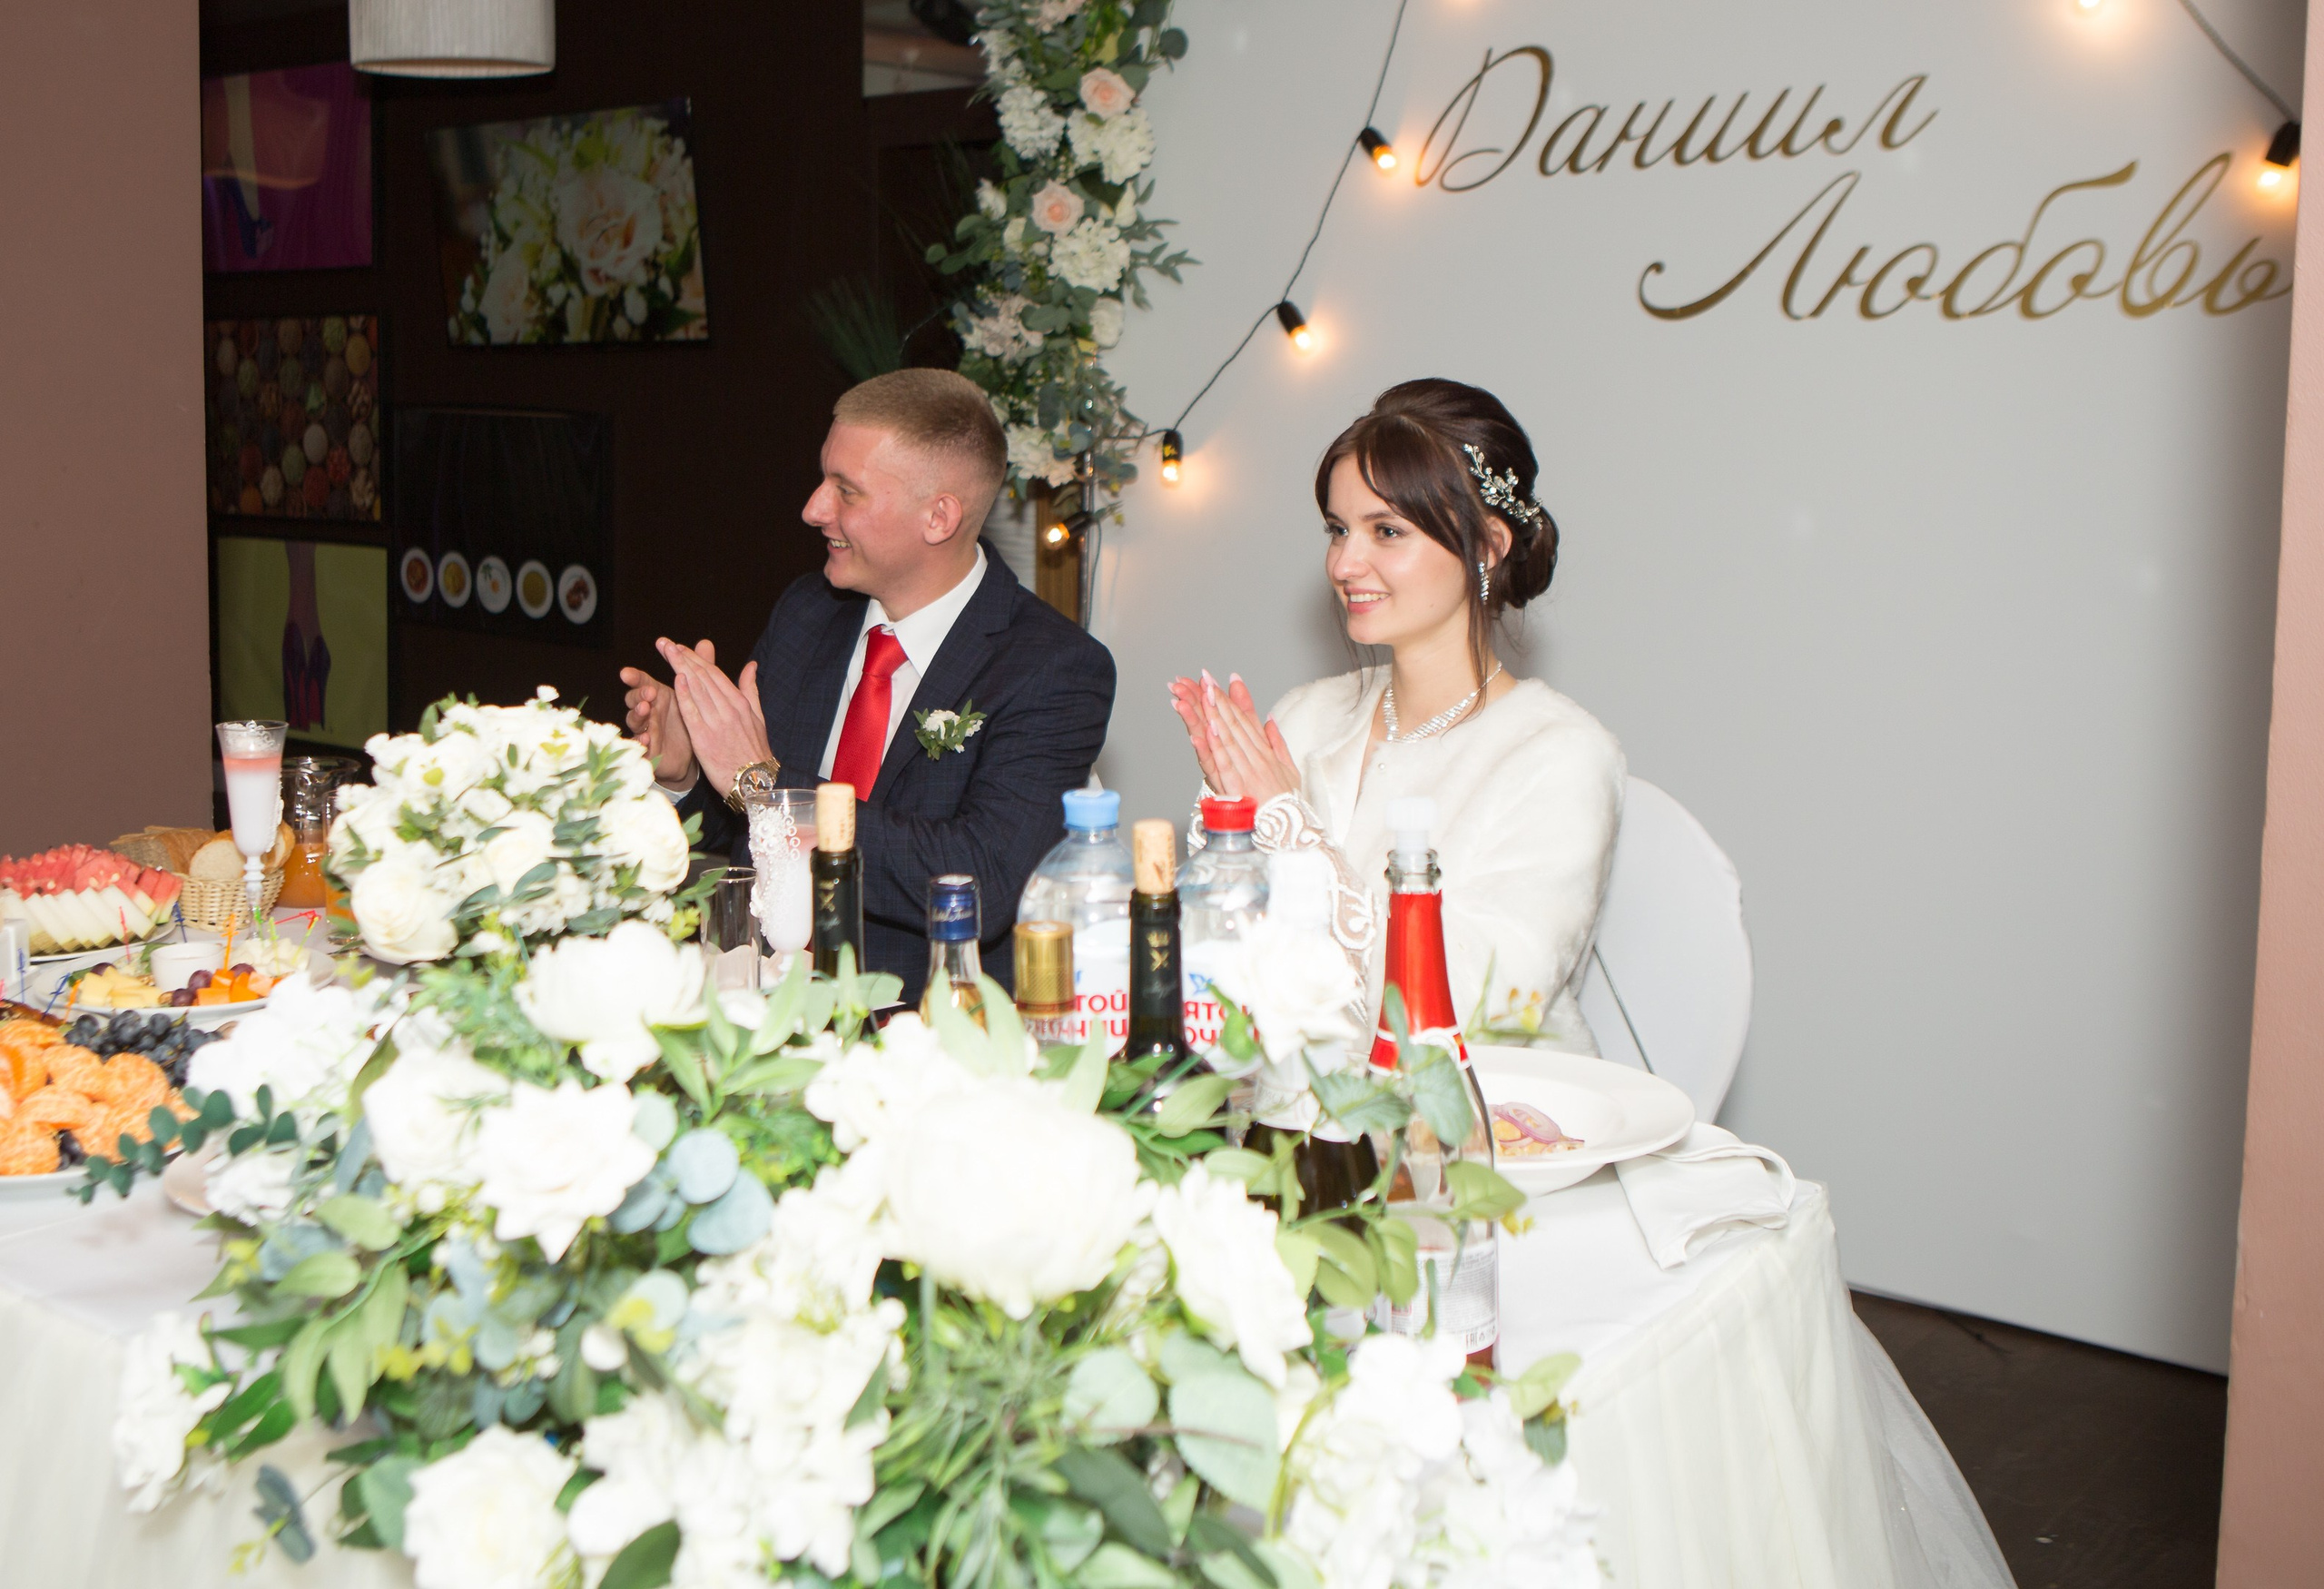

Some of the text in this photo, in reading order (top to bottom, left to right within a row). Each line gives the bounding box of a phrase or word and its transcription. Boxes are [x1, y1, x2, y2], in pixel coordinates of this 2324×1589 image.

[1415, 45, 1939, 192] Даниил
[1640, 152, 2293, 320] Любовь
[1074, 989, 1128, 1012] ТОЙ
